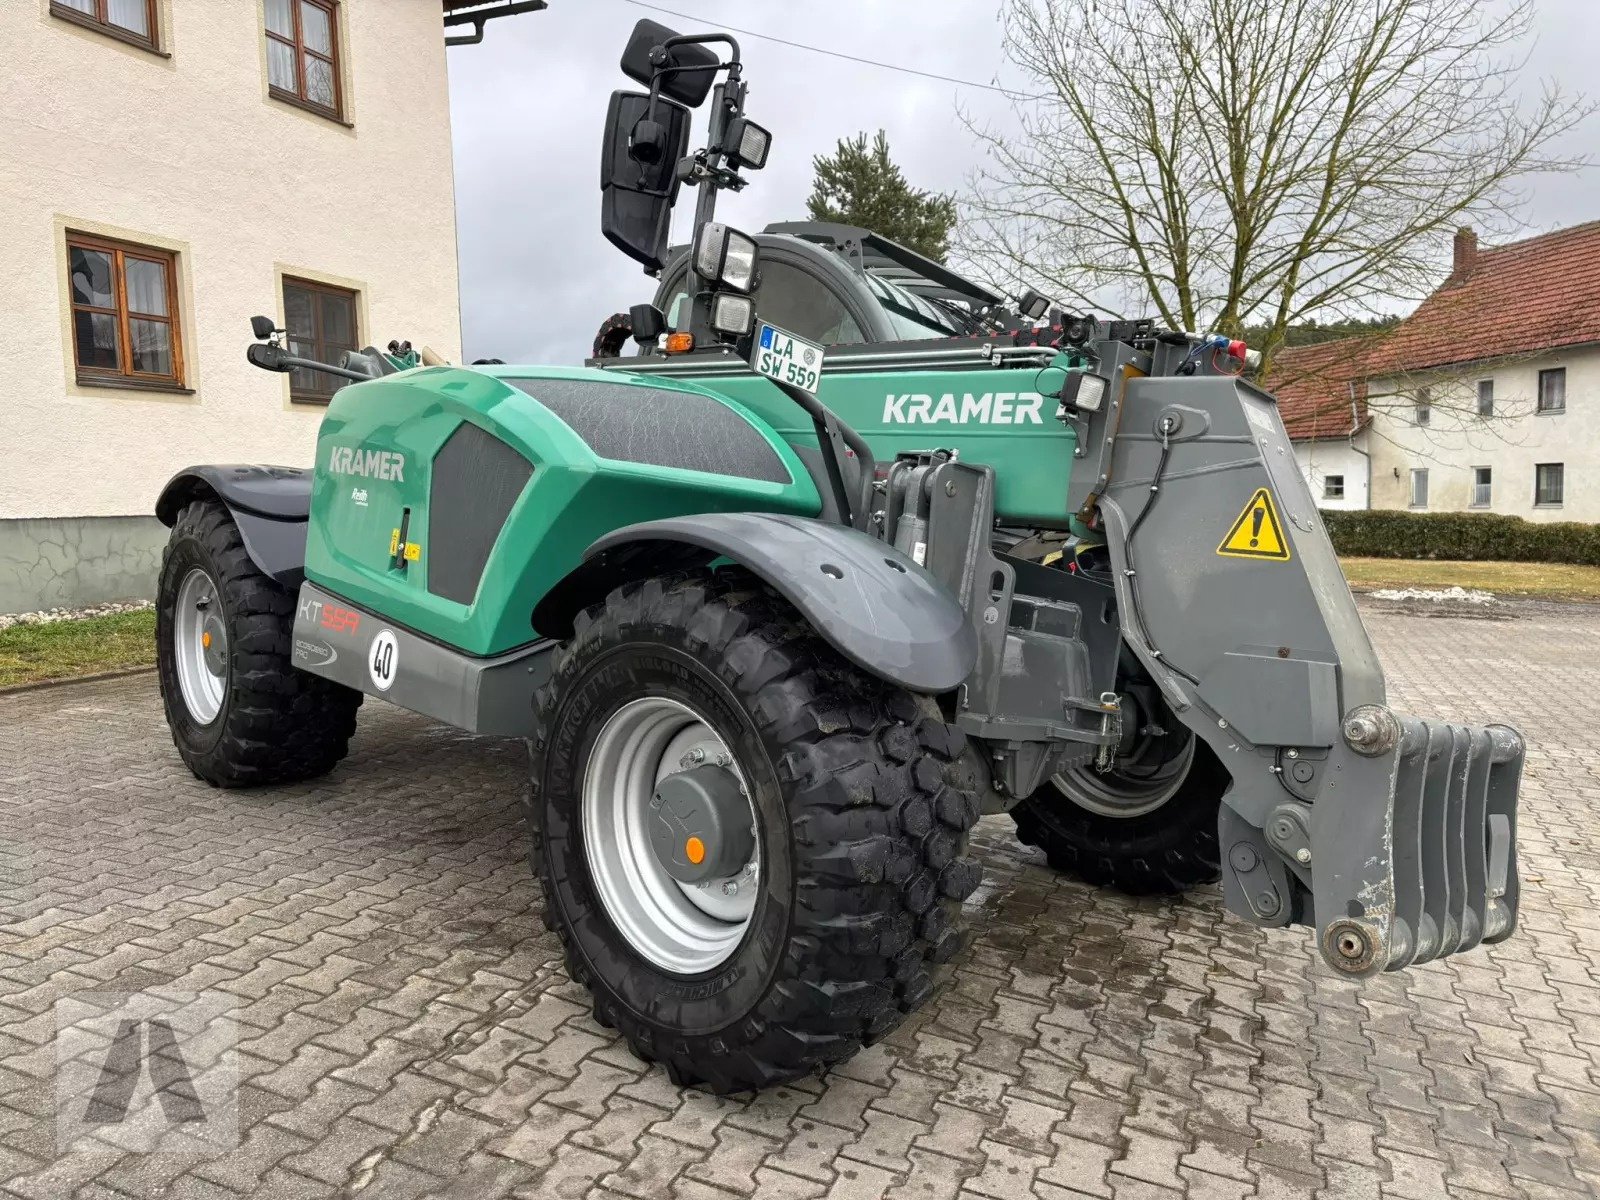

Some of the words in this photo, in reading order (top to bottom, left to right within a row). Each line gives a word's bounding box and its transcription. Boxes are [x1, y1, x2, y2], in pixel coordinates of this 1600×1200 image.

[773, 335, 793, 359] LA
[761, 353, 783, 377] SW
[786, 363, 816, 389] 559
[882, 393, 1044, 424] KRAMER
[329, 446, 405, 483] KRAMER
[374, 640, 393, 680] 40
